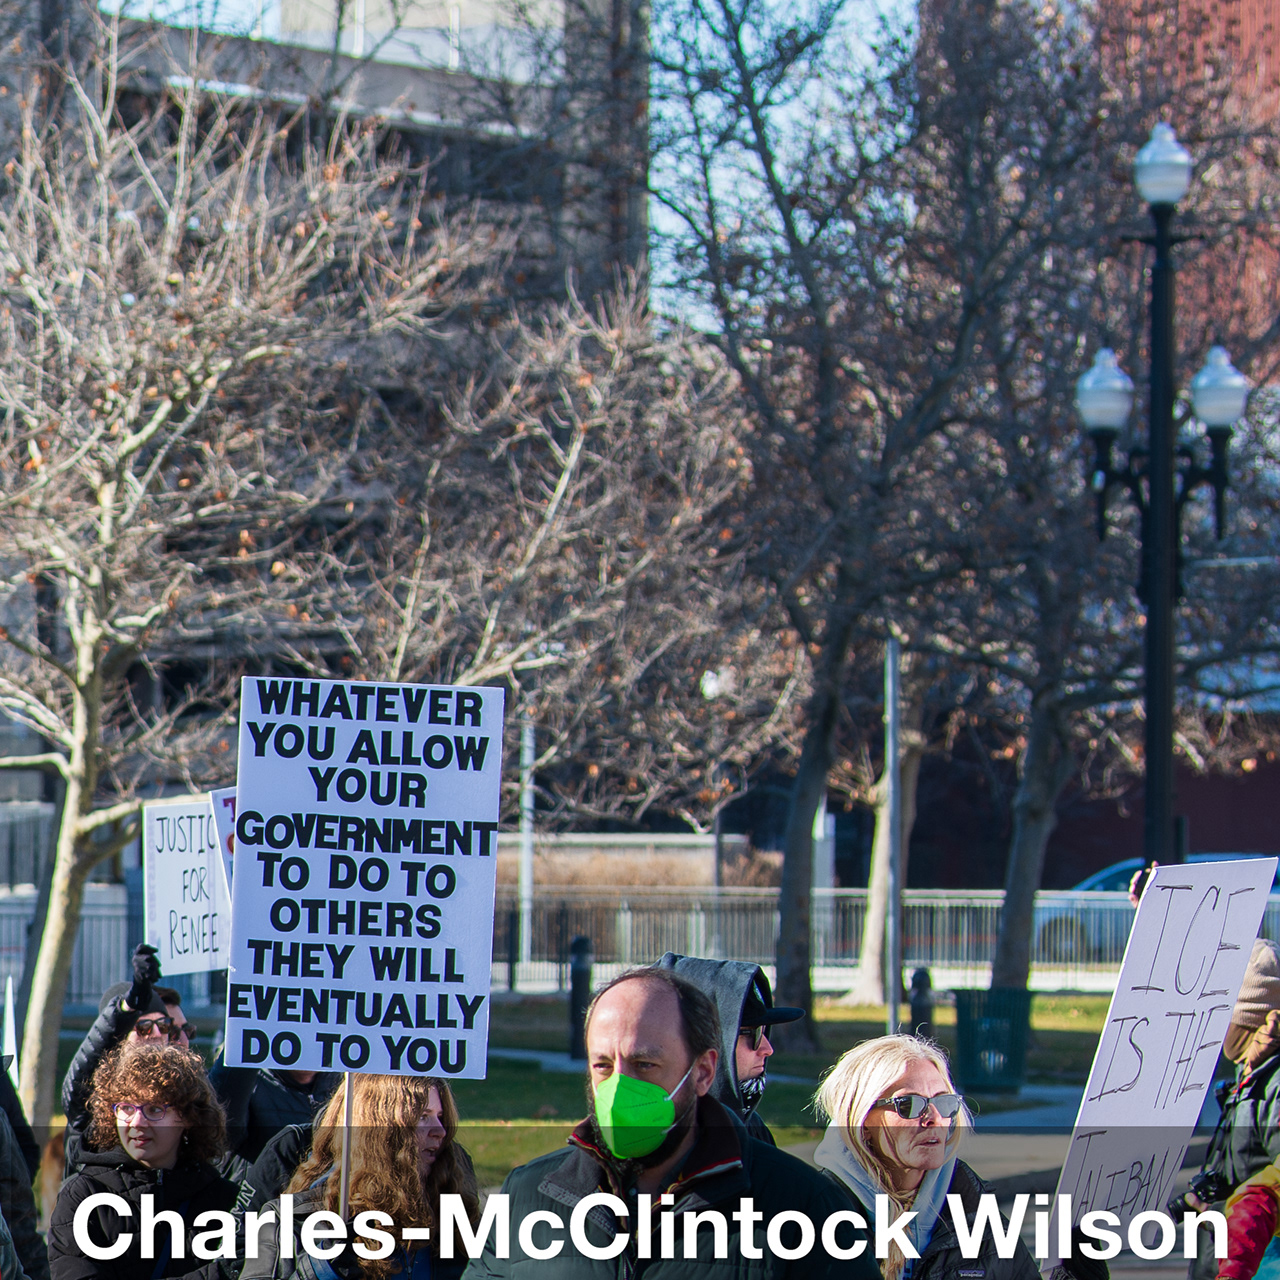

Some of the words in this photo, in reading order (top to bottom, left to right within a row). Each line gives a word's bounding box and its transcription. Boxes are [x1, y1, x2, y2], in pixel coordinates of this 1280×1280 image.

[256, 679, 483, 727] WHATEVER
[246, 721, 336, 761] YOU
[345, 729, 490, 771] ALLOW
[308, 766, 428, 808] YOUR
[235, 810, 499, 857] GOVERNMENT
[183, 866, 210, 903] FOR
[256, 851, 310, 892] TO
[329, 854, 390, 893] DO
[400, 861, 457, 900] TO
[169, 910, 219, 959] RENEE
[269, 897, 443, 939] OTHERS
[247, 939, 355, 980] THEY
[369, 945, 465, 983] WILL
[1130, 884, 1256, 1001] ICE
[228, 983, 486, 1030] EVENTUALLY
[241, 1029, 302, 1065] DO
[316, 1032, 370, 1069] TO
[381, 1035, 468, 1074] YOU
[1088, 1015, 1150, 1103] IS
[1154, 1004, 1231, 1110] THE
